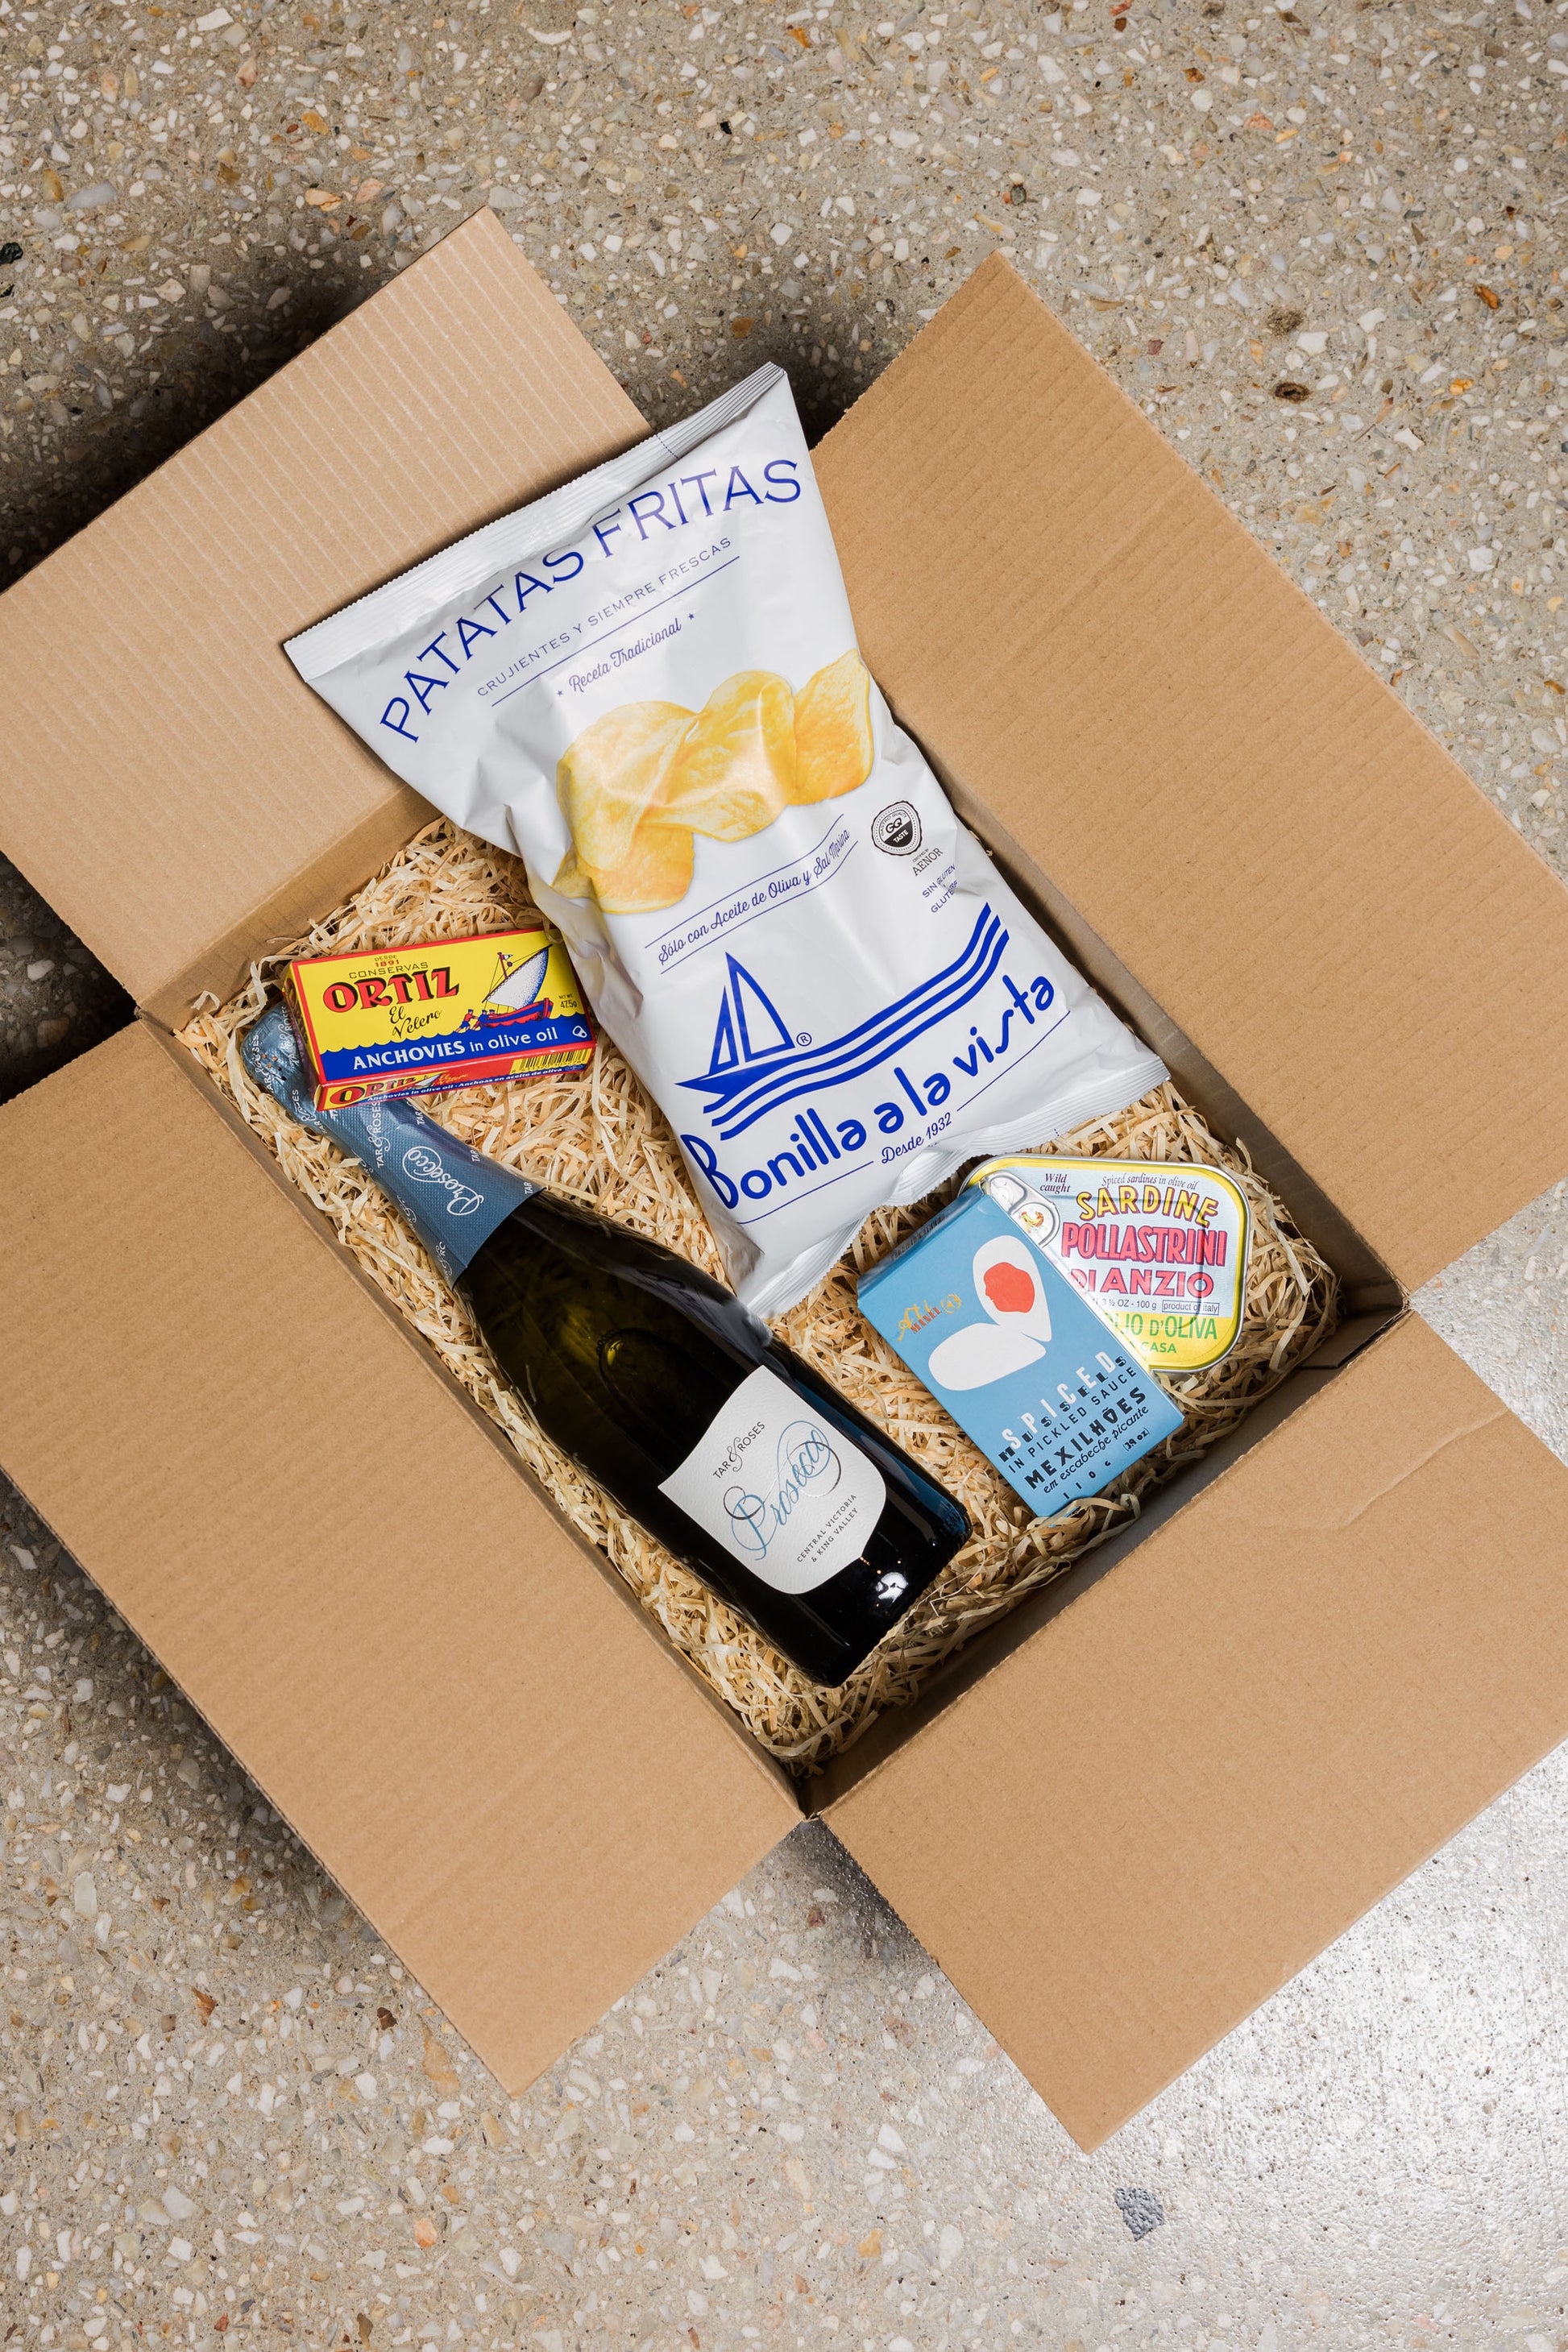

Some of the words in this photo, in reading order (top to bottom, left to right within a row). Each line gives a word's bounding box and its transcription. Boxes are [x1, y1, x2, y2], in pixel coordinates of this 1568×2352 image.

[380, 550, 584, 743] PATATAS
[592, 458, 802, 558] FRITAS
[477, 633, 570, 697] CRUJIENTES
[573, 623, 583, 634] Y
[587, 582, 656, 626] SIEMPRE
[659, 537, 731, 585] FRESCAS
[568, 662, 611, 693] Receta
[610, 617, 682, 668] Tradicional
[886, 817, 902, 834] GQ
[893, 829, 909, 843] TASTE
[912, 848, 944, 877] AENOR
[922, 882, 938, 898] SIN
[936, 864, 956, 885] GLUTEN
[658, 940, 686, 965] Sólo
[687, 925, 709, 943] con
[711, 901, 749, 929] Aceite
[751, 890, 766, 906] de
[768, 874, 801, 898] Oliva
[803, 870, 811, 886] y
[813, 852, 831, 878] Sal
[828, 829, 850, 861] Marina
[349, 961, 428, 979] CONSERVAS
[375, 960, 400, 968] 1891
[323, 967, 460, 1013] ORTIZ
[389, 1006, 406, 1024] El
[392, 1010, 442, 1039] Velero
[354, 1040, 466, 1070] ANCHOVIES
[470, 1041, 483, 1052] in
[487, 1034, 531, 1051] olive
[537, 1027, 558, 1040] oil
[330, 1076, 417, 1105] ORTIZ
[367, 1092, 409, 1101] Anchovies
[459, 1078, 492, 1088] Anchoas
[506, 1072, 529, 1081] aceite
[681, 1106, 868, 1209] Bonilla
[873, 1097, 905, 1134] a
[894, 1067, 952, 1116] la
[953, 974, 1055, 1077] vista
[415, 1111, 425, 1126] TAR
[881, 1136, 924, 1164] Desde
[926, 1112, 952, 1139] 1932
[375, 1148, 384, 1168] TAR
[470, 1150, 480, 1162] TAR
[403, 1146, 483, 1216] Prosecco
[524, 1181, 533, 1194] TAR
[1040, 1183, 1071, 1194] caught
[1045, 1173, 1068, 1184] Wild
[1101, 1173, 1126, 1187] Spiced
[1126, 1173, 1157, 1184] sardines
[1159, 1173, 1167, 1184] in
[1168, 1175, 1186, 1188] olive
[1186, 1180, 1198, 1190] oil
[1076, 1185, 1219, 1228] SARDINE
[1061, 1222, 1228, 1267] POLLASTRINI
[1100, 1267, 1214, 1298] ANZIO
[1117, 1299, 1130, 1308] OZ
[1137, 1300, 1150, 1309] 100
[1164, 1302, 1192, 1312] product
[1193, 1303, 1201, 1311] of
[1202, 1304, 1218, 1313] Italy
[998, 1356, 1126, 1462] MUSSELS
[1002, 1351, 1116, 1450] SPICED
[1009, 1458, 1025, 1473] IN
[1028, 1407, 1087, 1457] PICKLED
[1091, 1367, 1136, 1405] SAUCE
[713, 1461, 731, 1479] TAR
[737, 1421, 765, 1452] ROSES
[1024, 1387, 1146, 1490] MEXILHÕES
[1043, 1479, 1059, 1493] em
[1060, 1436, 1111, 1480] escabeche
[1111, 1406, 1149, 1439] picante
[731, 1421, 831, 1561] Prosecco
[797, 1530, 826, 1562] CENTRAL
[825, 1494, 857, 1528] VICTORIA
[817, 1537, 835, 1555] KING
[834, 1508, 858, 1534] VALLEY
